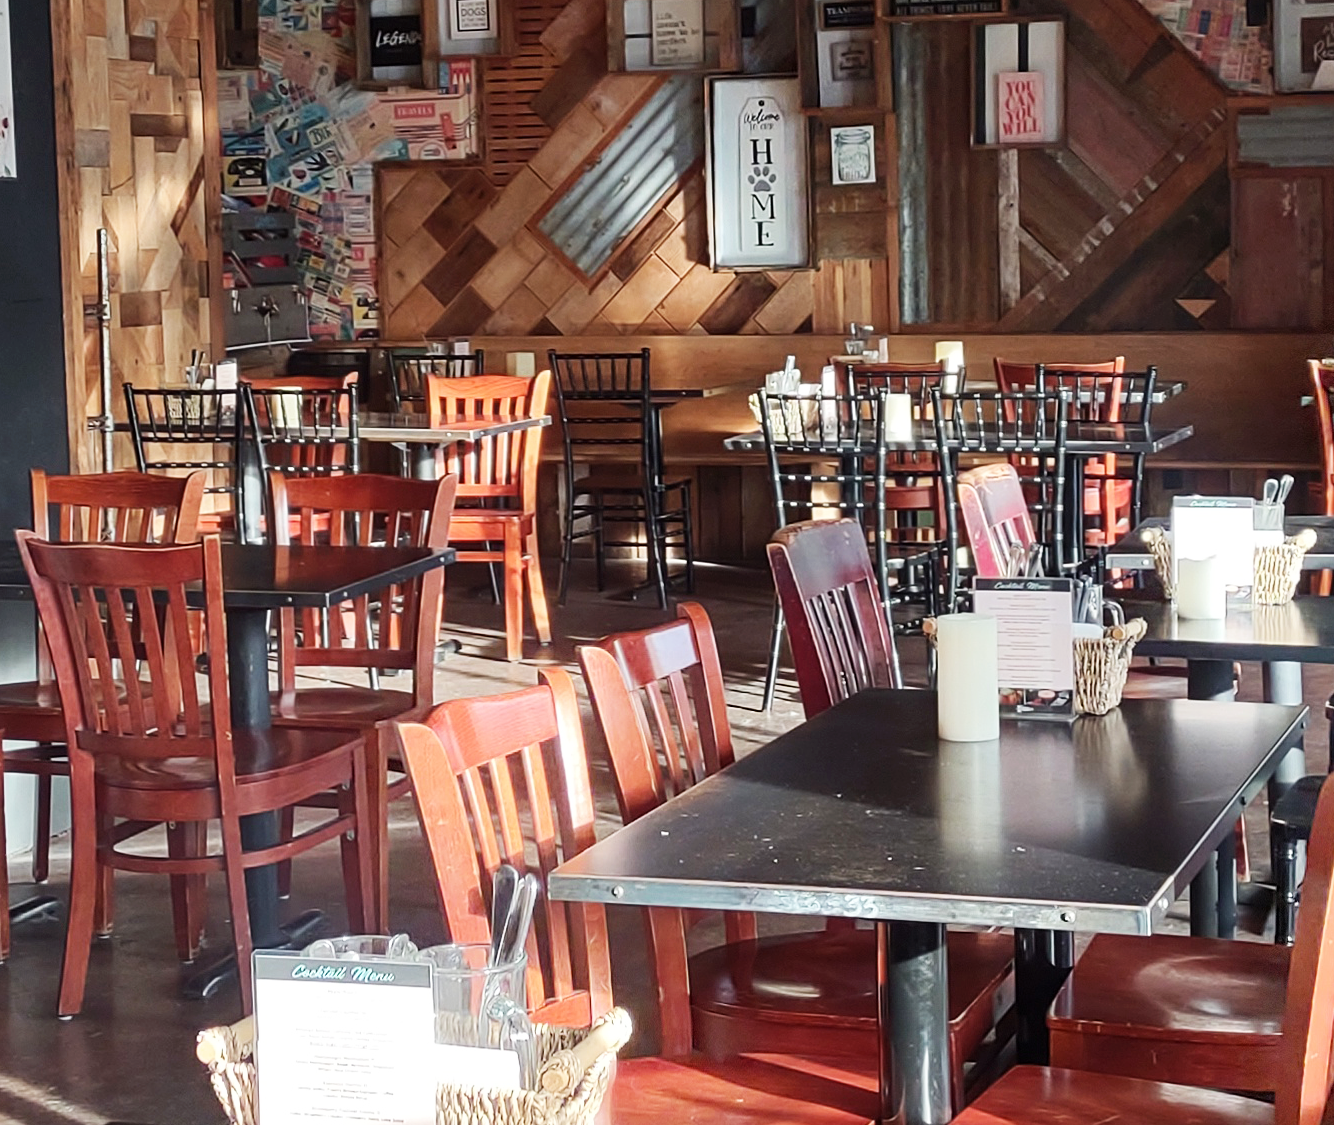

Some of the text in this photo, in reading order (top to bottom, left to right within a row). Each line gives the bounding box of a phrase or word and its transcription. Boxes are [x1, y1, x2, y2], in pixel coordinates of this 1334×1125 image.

[461, 8, 486, 16] DOGS
[744, 109, 780, 124] Welcome
[292, 964, 395, 983] Cocktail Menu
